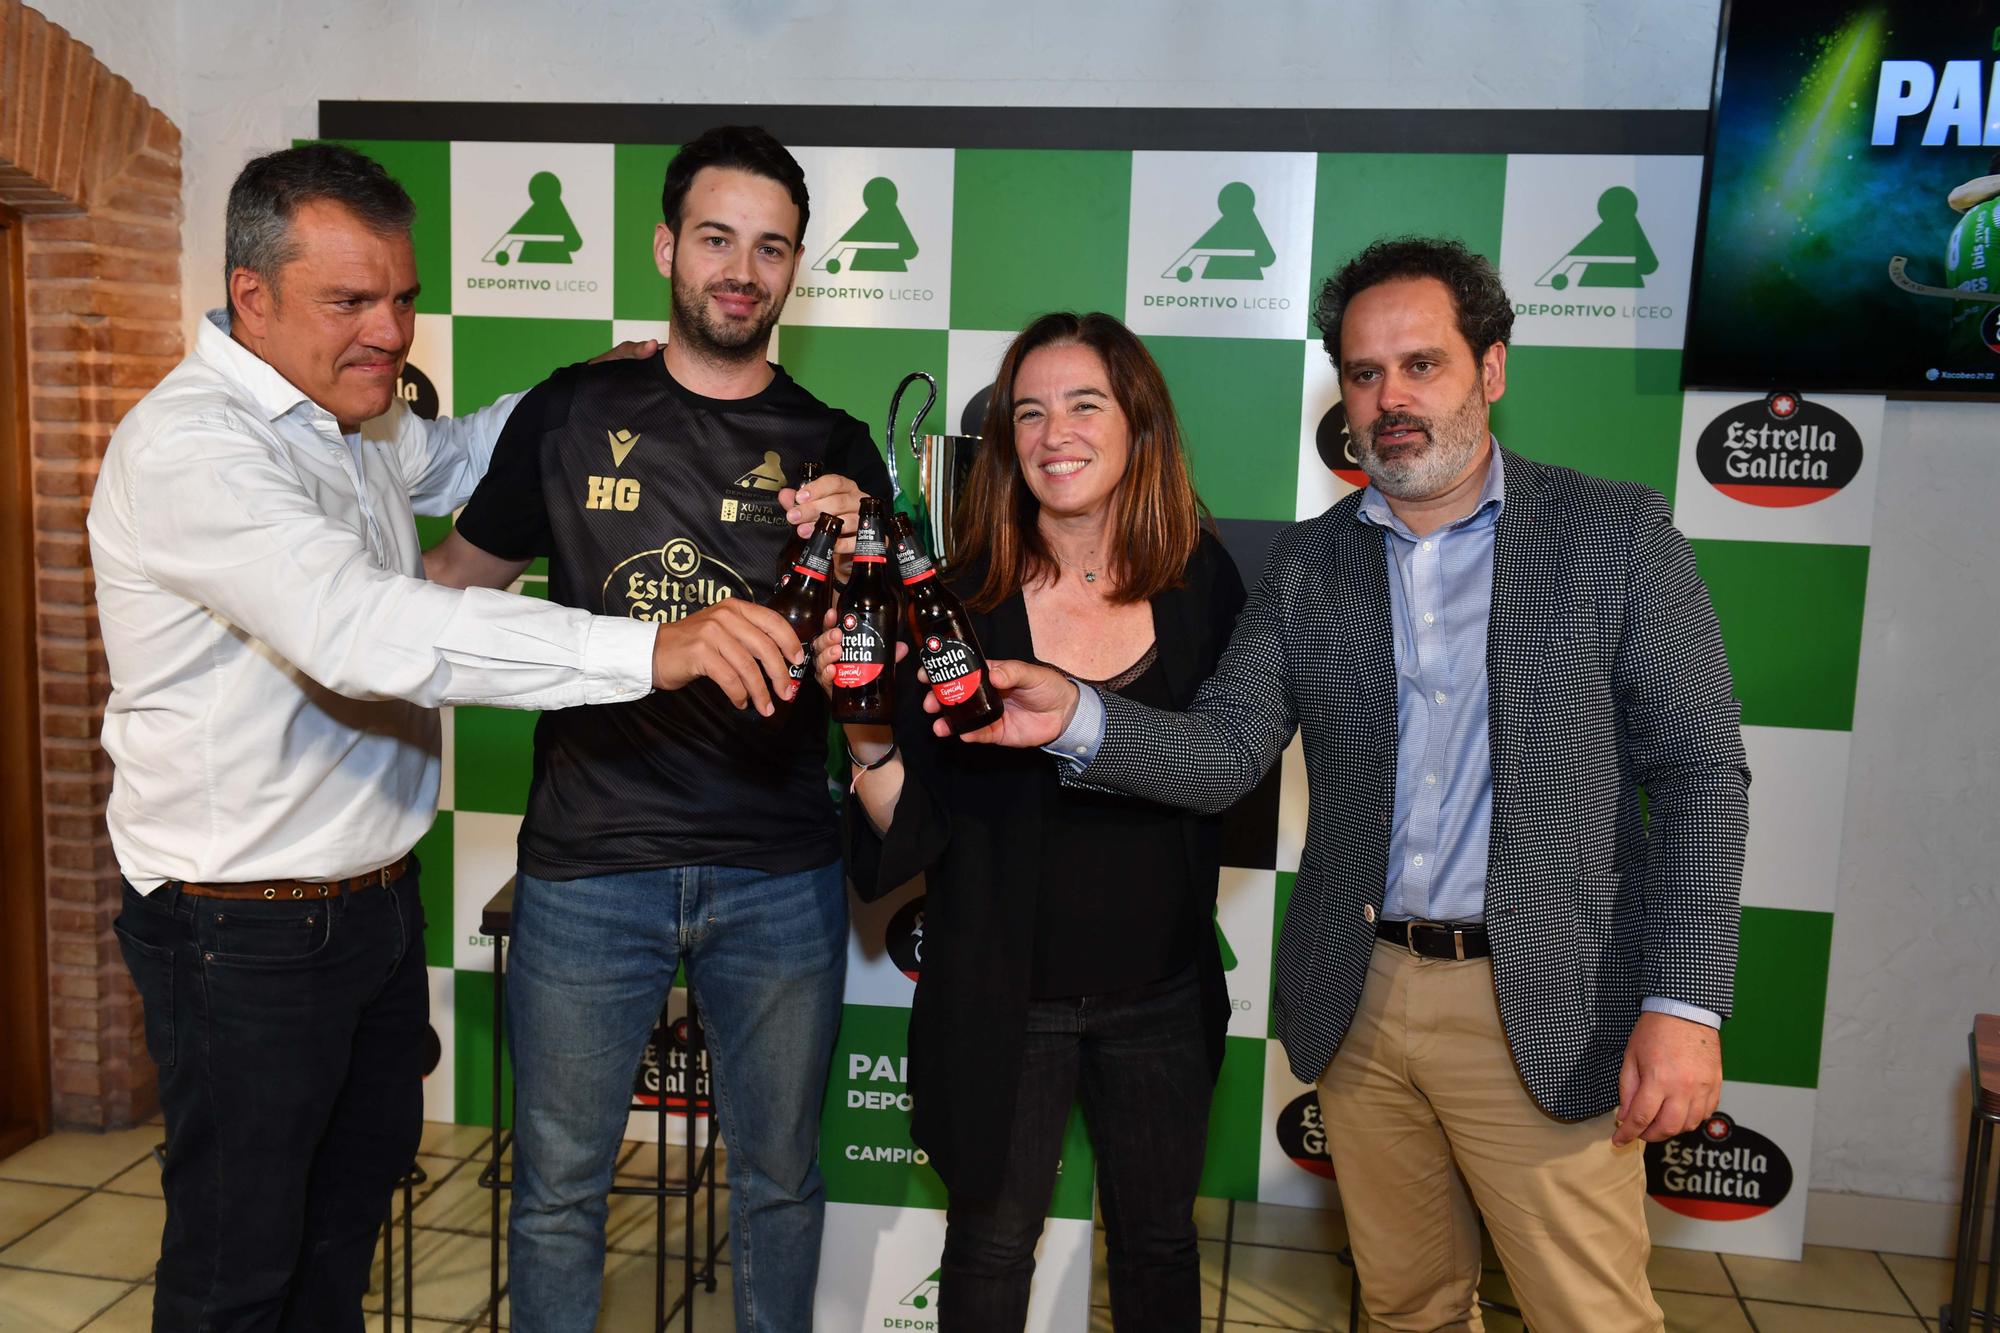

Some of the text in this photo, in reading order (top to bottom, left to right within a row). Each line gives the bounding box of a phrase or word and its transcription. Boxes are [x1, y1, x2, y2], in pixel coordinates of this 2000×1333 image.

[467, 278, 598, 292] DEPORTIVO LICEO
[795, 287, 934, 301] DEPORTIVO LICEO
[1143, 296, 1290, 310] DEPORTIVO LICEO
[1515, 304, 1673, 319] DEPORTIVO LICEO
[1723, 421, 1836, 452] Estrella
[1726, 450, 1829, 481] Galicia
[586, 476, 641, 512] HG
[739, 512, 752, 522] DE
[741, 503, 773, 514] XUNTA
[626, 571, 733, 606] Estrella
[841, 633, 875, 647] trella
[840, 648, 872, 662] alicia
[922, 648, 966, 670] Estrella
[927, 662, 969, 684] Galicia
[1661, 1140, 1767, 1174] Estrella
[1664, 1166, 1760, 1199] Galicia
